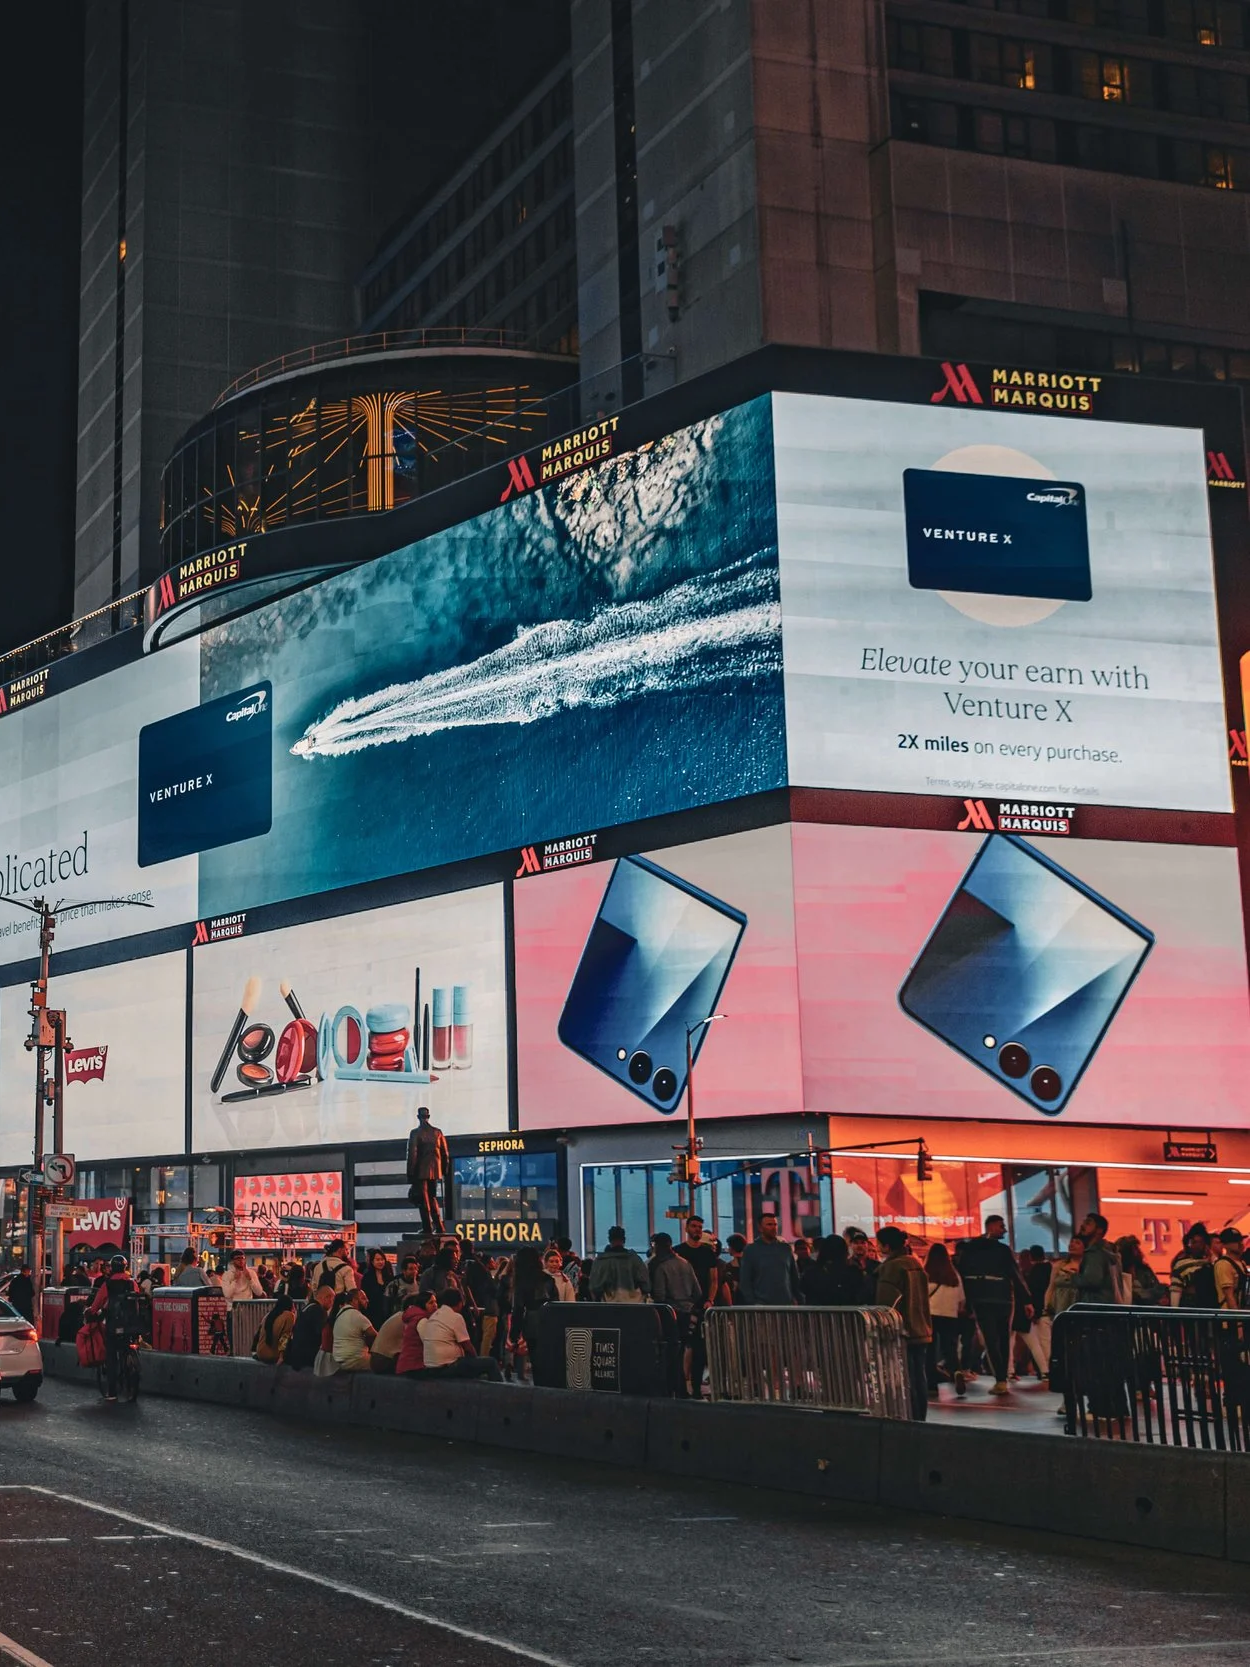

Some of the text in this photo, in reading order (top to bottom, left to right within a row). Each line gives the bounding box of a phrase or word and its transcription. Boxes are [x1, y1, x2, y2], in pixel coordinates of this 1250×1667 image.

[993, 369, 1102, 393] MARRIOTT
[993, 388, 1090, 411] MARQUIS
[541, 415, 619, 462] MARRIOTT
[541, 437, 611, 480] MARQUIS
[923, 527, 1013, 545] VENTURE X
[179, 543, 248, 581] MARRIOTT
[179, 562, 238, 597] MARQUIS
[860, 647, 1150, 690] Elevate your earn with
[10, 669, 49, 694] MARRIOTT
[10, 684, 45, 707] MARQUIS
[943, 691, 1074, 723] Venture X
[897, 733, 1123, 763] 2X miles on every purchase.
[150, 773, 213, 803] VENTURE X
[925, 776, 950, 787] Terms
[999, 803, 1075, 819] MARRIOTT
[1000, 817, 1068, 832] MARQUIS
[544, 834, 597, 855] MARRIOTT
[544, 847, 591, 867] MARQUIS
[13, 916, 42, 935] benefits
[60, 909, 79, 927] price
[80, 901, 98, 917] that
[98, 894, 125, 913] makes
[126, 889, 154, 907] sense.
[211, 913, 246, 929] MARRIOTT
[211, 924, 243, 940] MARQUIS
[478, 1138, 524, 1152] SEPHORA
[251, 1199, 323, 1221] PANDORA
[455, 1222, 542, 1242] SEPHORA
[595, 1342, 615, 1354] TIMES
[593, 1355, 616, 1368] SQUARE
